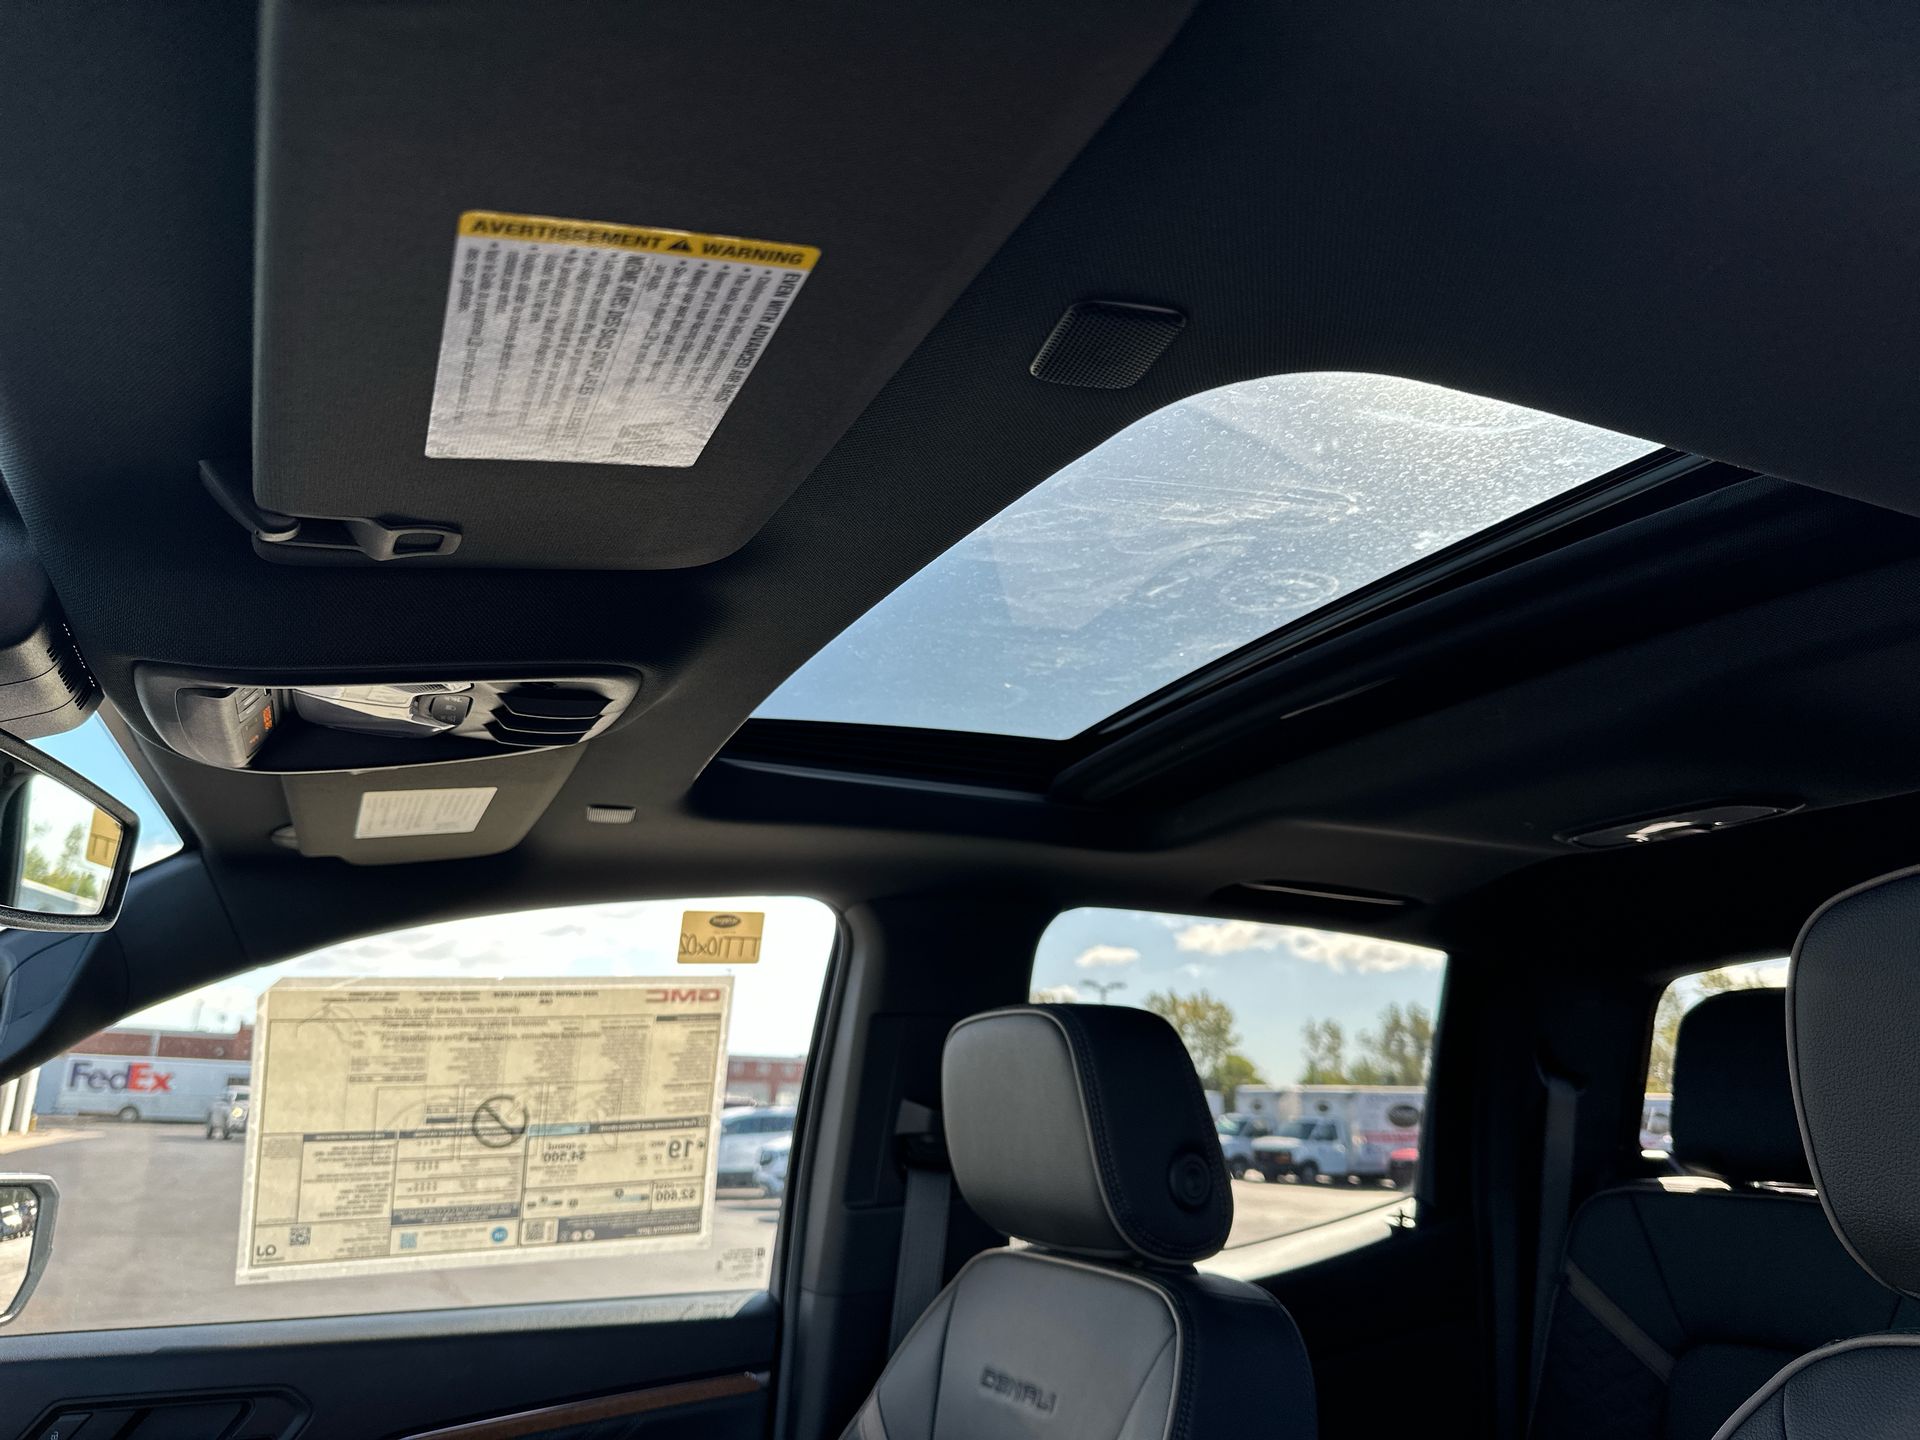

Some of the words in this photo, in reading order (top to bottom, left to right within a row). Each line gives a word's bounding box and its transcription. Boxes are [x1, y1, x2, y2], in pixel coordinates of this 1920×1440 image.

[472, 219, 669, 250] AVERTISSEMENT
[701, 241, 806, 266] WARNING
[772, 272, 802, 297] EVEN
[758, 299, 787, 323] WITH
[732, 324, 773, 368] ADVANCED
[70, 1062, 174, 1094] FedEx
[980, 1366, 1057, 1414] DENALI
